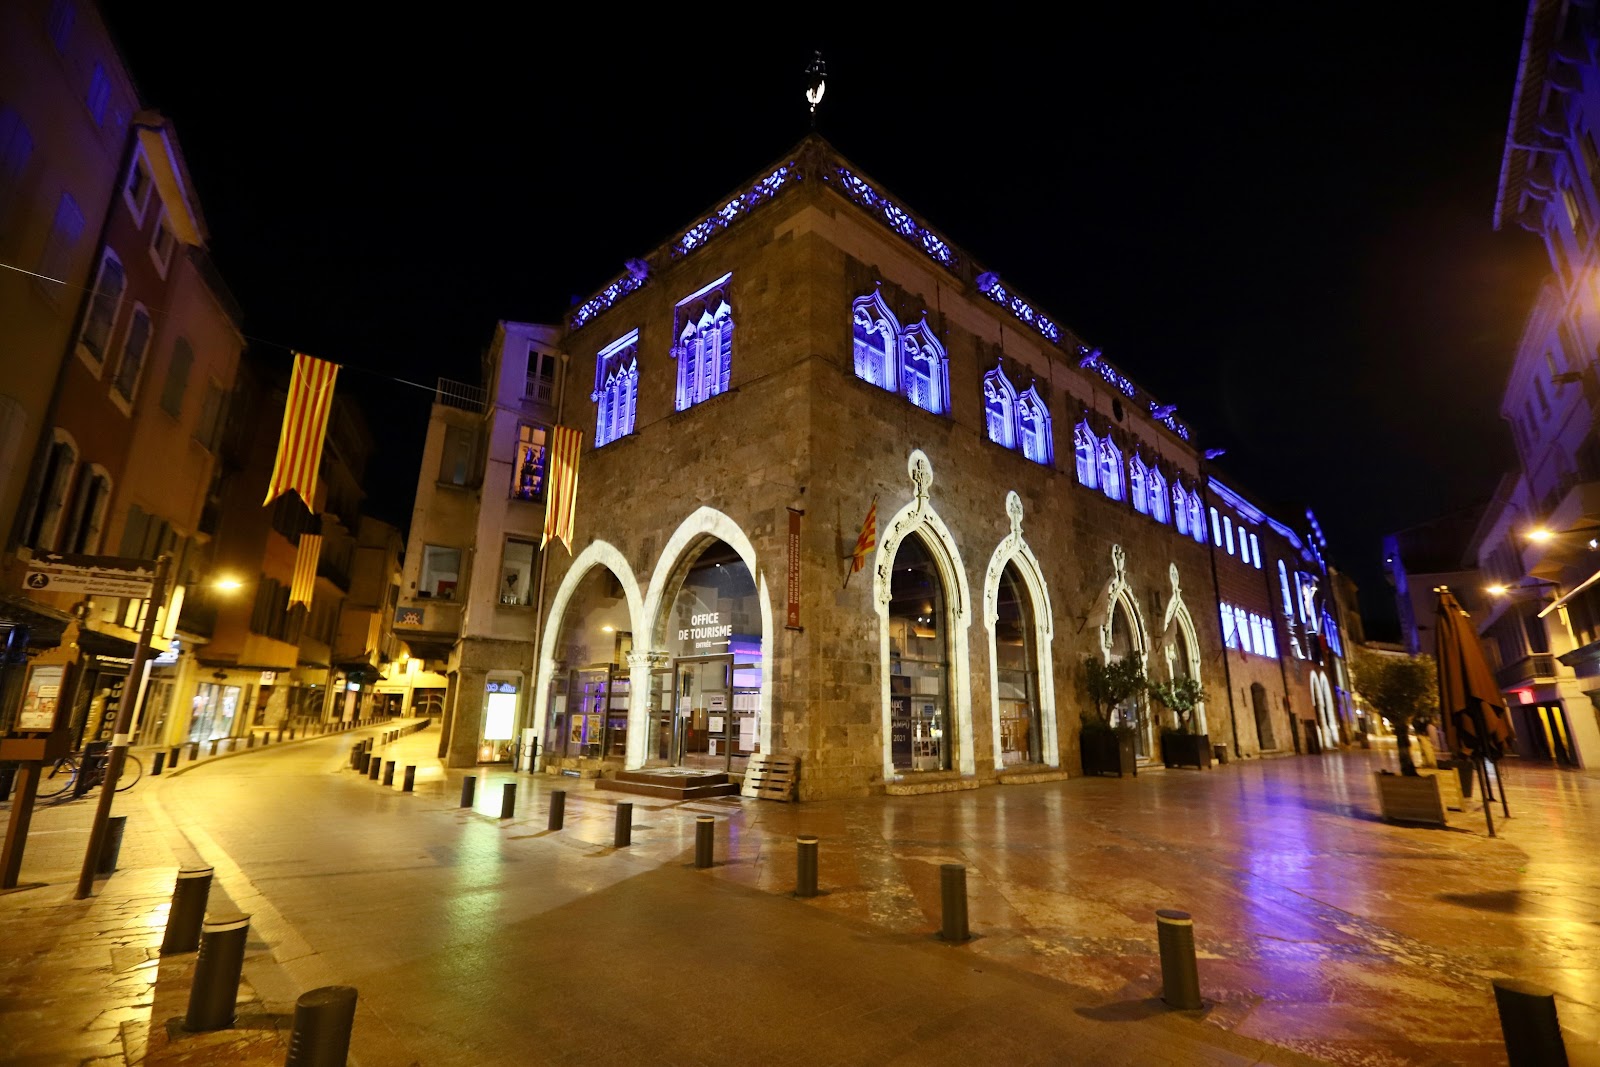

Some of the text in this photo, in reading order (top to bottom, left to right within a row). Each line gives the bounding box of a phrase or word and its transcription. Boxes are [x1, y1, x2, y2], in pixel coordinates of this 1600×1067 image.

[691, 612, 719, 626] OFFICE
[678, 624, 732, 641] DE TOURISME
[695, 640, 712, 649] ENTRÉE
[893, 734, 906, 742] 2021
